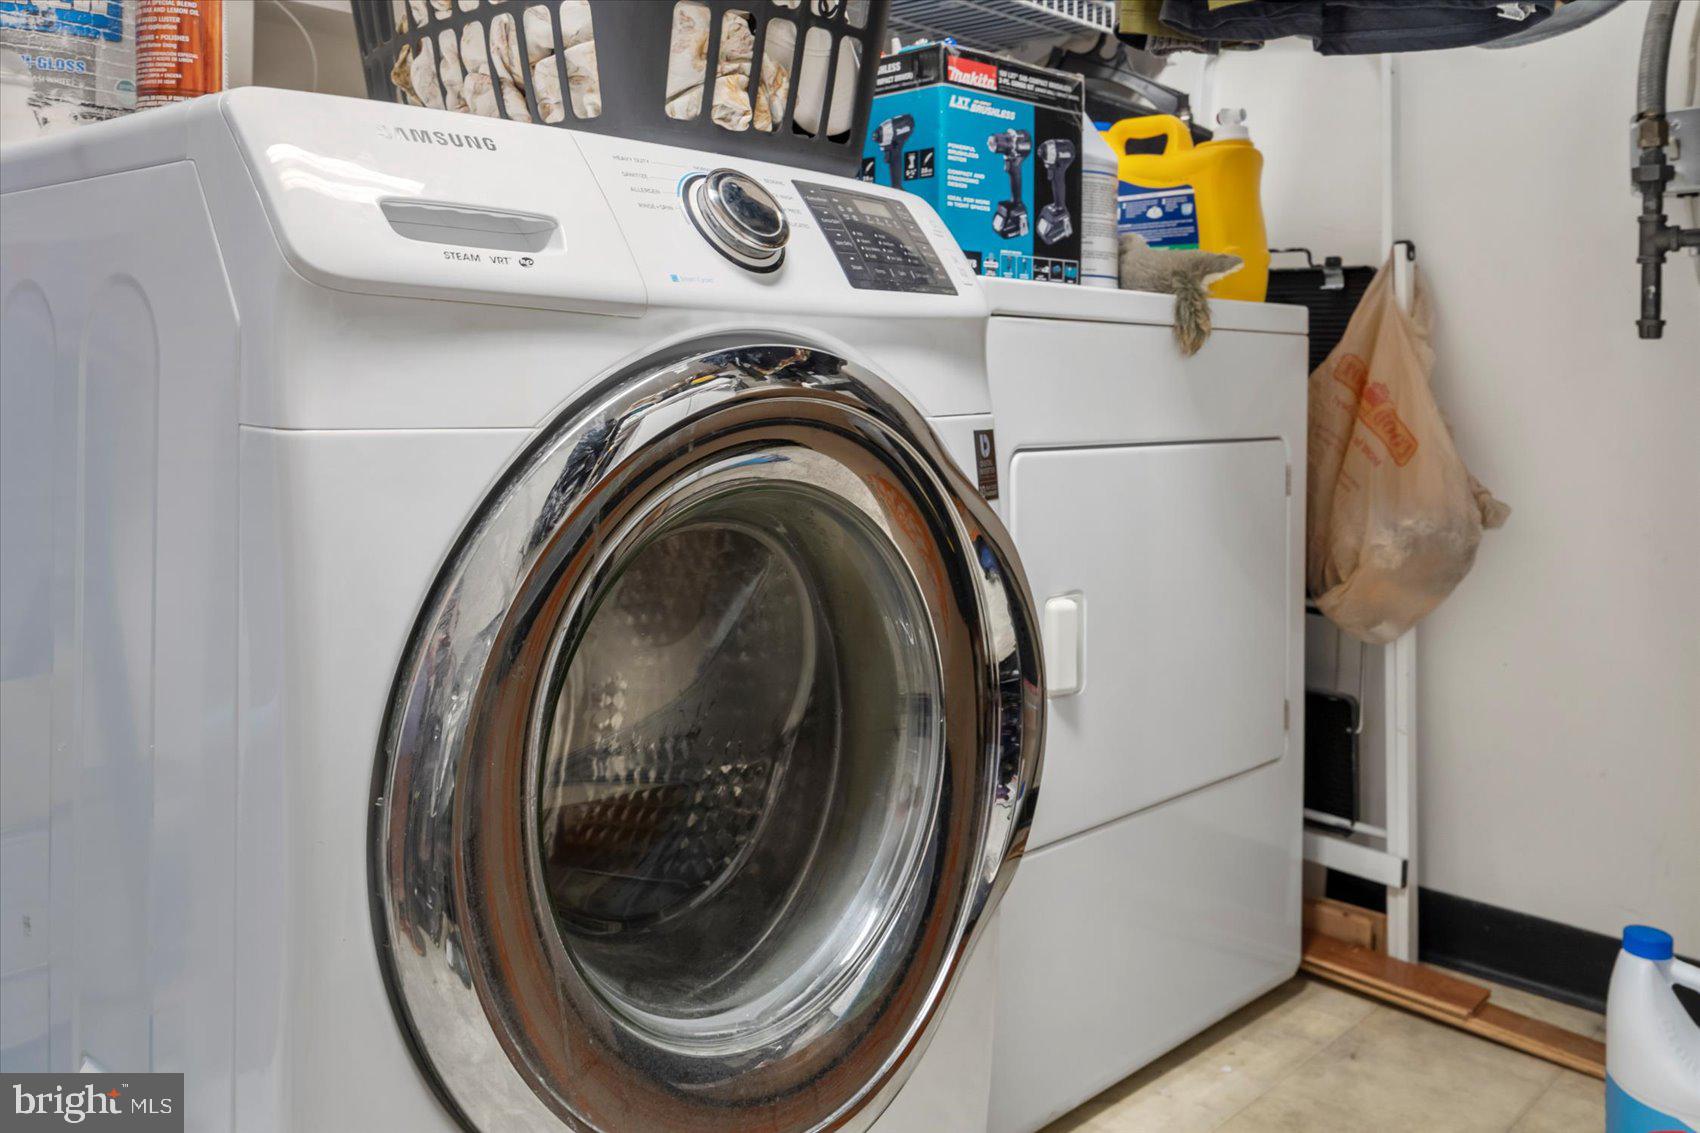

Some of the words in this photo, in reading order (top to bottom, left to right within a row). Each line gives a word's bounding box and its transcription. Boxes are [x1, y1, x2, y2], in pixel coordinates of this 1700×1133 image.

[160, 34, 190, 42] POLISHES
[377, 125, 497, 151] SAMSUNG
[443, 250, 481, 262] STEAM
